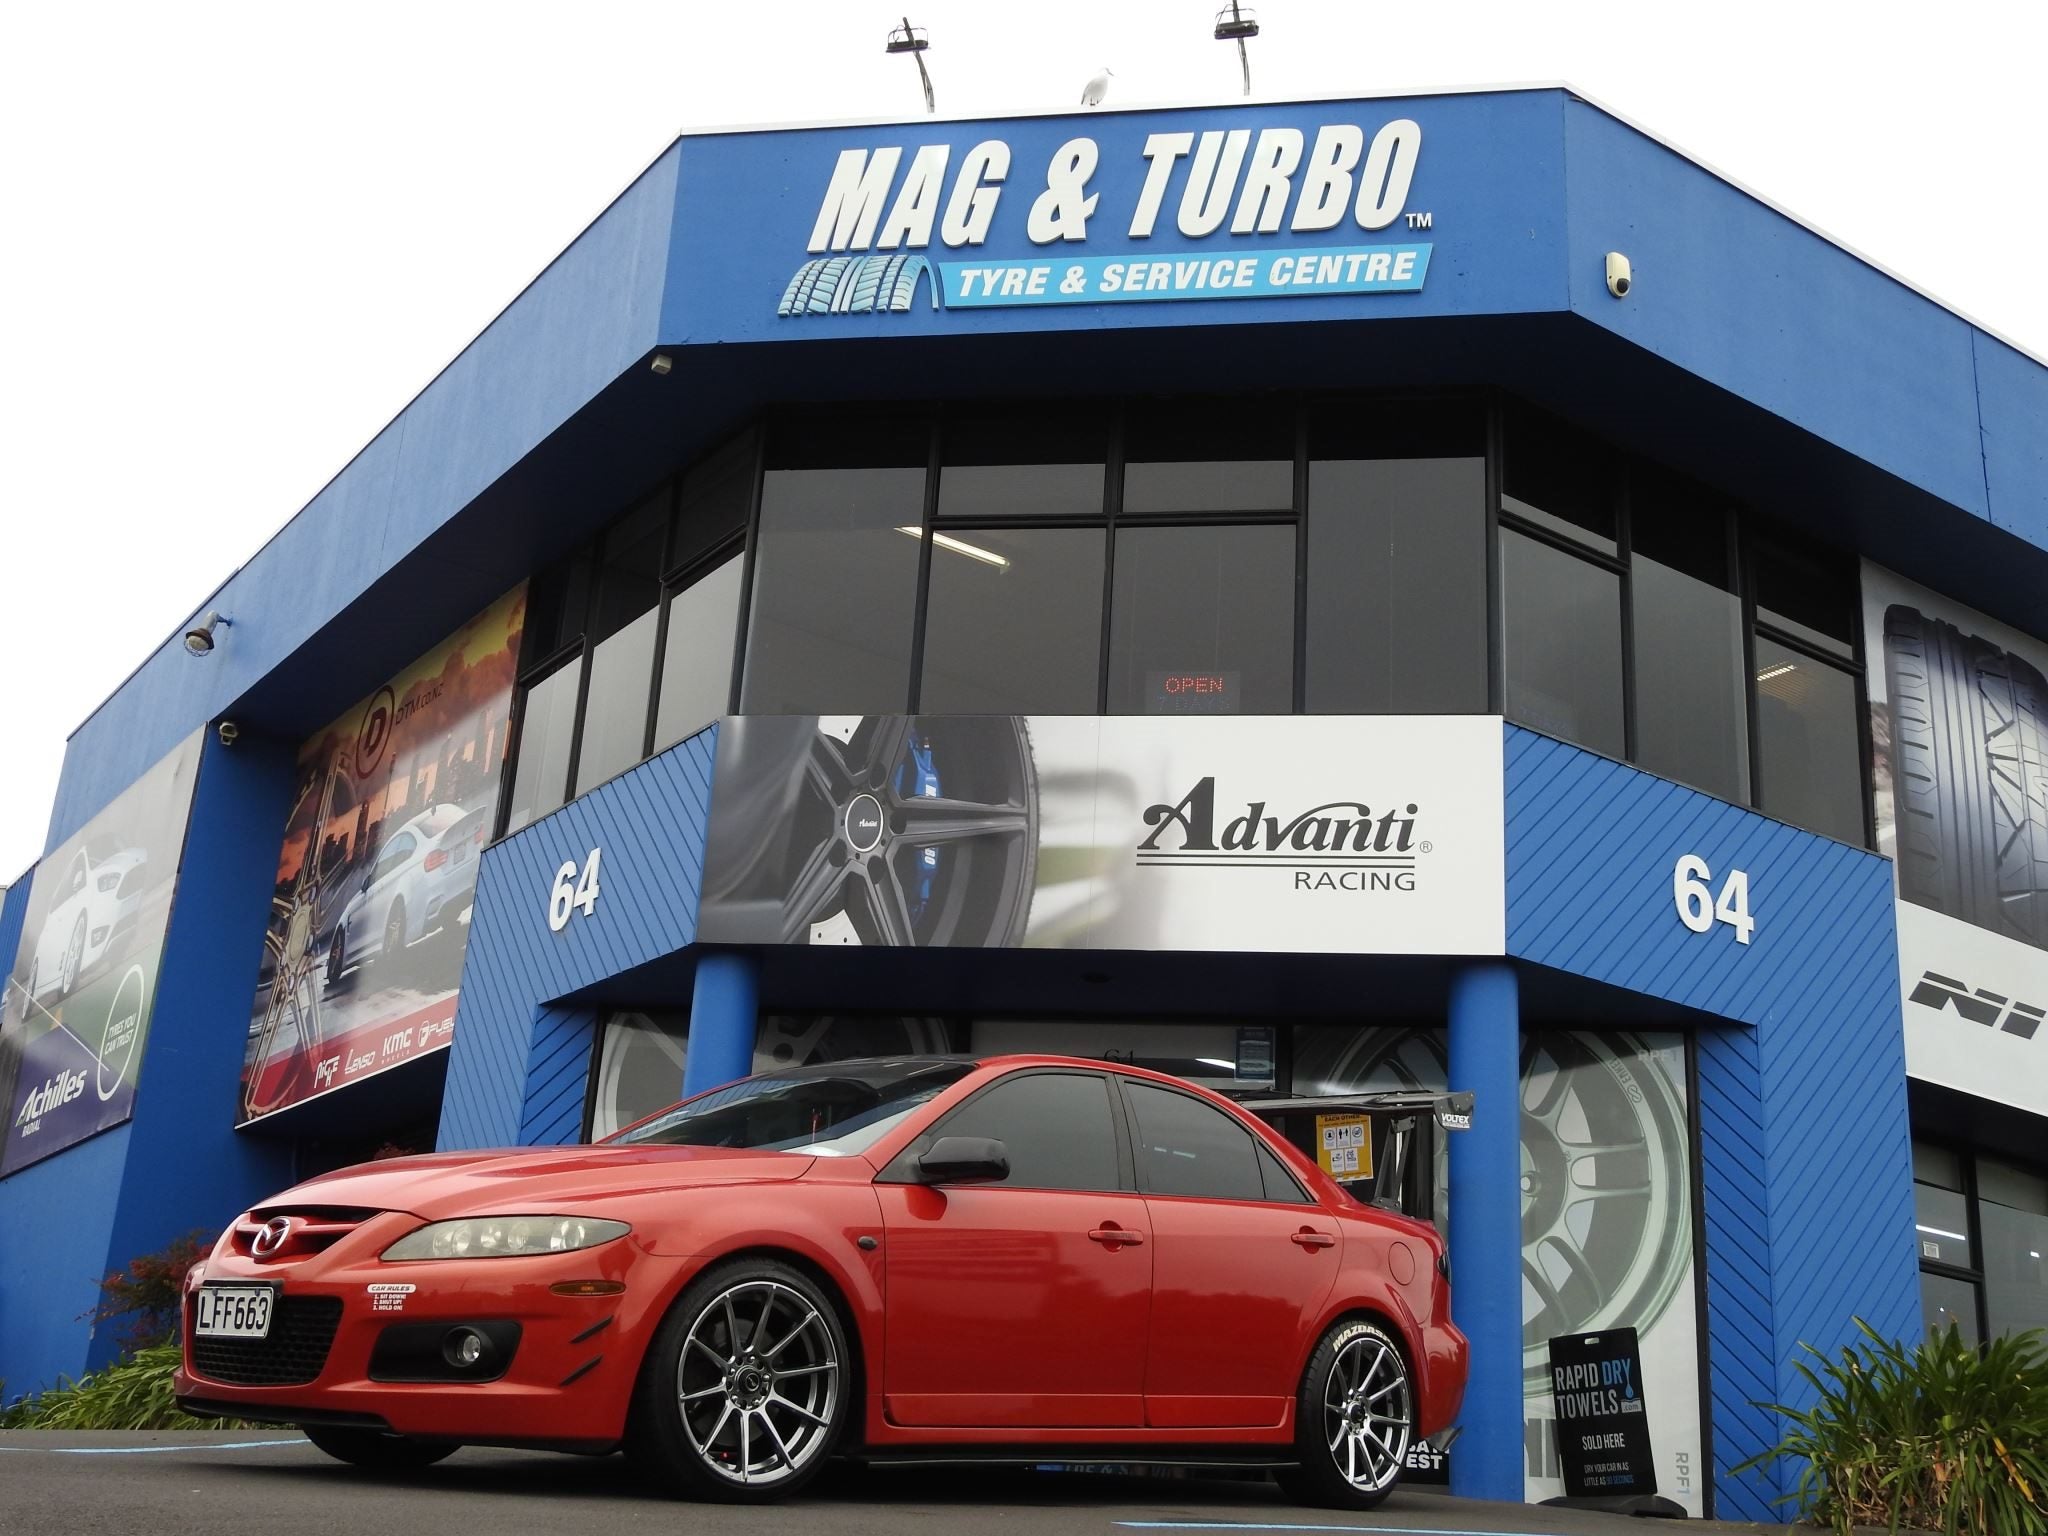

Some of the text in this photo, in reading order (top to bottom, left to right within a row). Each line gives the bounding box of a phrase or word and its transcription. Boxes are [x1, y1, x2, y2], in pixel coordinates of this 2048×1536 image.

[806, 140, 1011, 253] MAG
[1027, 137, 1099, 244] &
[1127, 119, 1422, 239] TURBO
[958, 251, 1417, 297] TYRE & SERVICE CENTRE
[1165, 677, 1224, 693] OPEN
[1136, 776, 1418, 853] Advanti
[549, 847, 602, 931] 64
[1294, 871, 1415, 891] RACING
[1674, 854, 1754, 945] 64
[382, 1027, 414, 1057] KMC
[15, 1068, 88, 1127] Achilles
[1441, 1113, 1470, 1124] VOLTEX
[199, 1296, 269, 1330] LFF663
[1555, 1358, 1631, 1391] RAPID DRY
[1556, 1388, 1619, 1419] TOWELS
[1581, 1432, 1626, 1451] SOLD HERE
[1584, 1464, 1594, 1474] DRY
[1594, 1463, 1606, 1473] YOUR
[1584, 1477, 1599, 1487] LITTLE
[1675, 1452, 1691, 1495] RPF1
